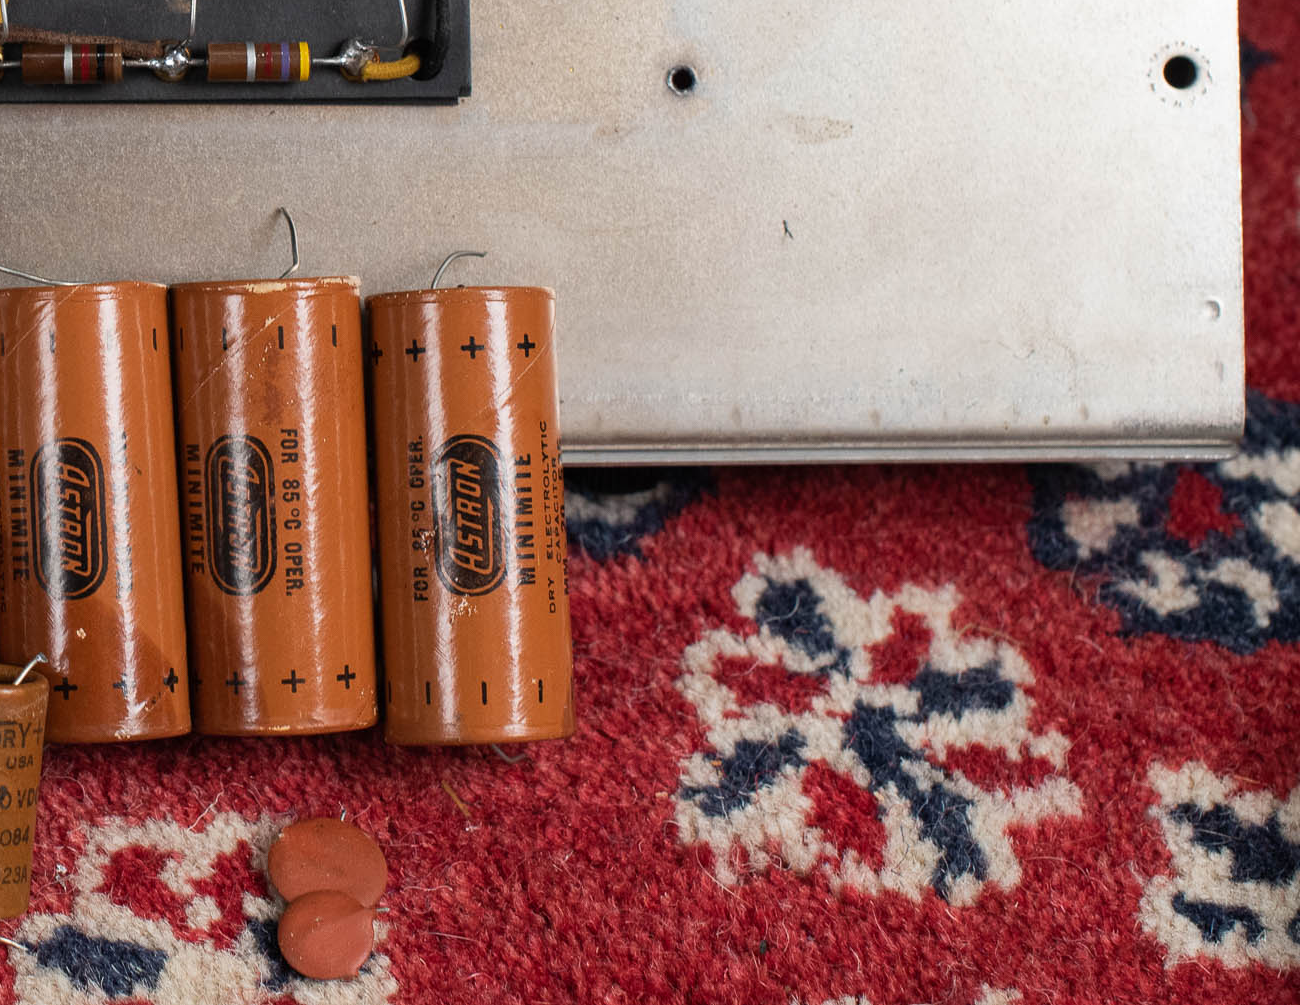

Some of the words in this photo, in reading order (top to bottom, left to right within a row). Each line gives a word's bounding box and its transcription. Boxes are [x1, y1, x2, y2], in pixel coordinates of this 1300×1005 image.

[281, 429, 298, 463] FOR
[409, 435, 425, 488] OPER.
[7, 449, 29, 582] MINIMITE
[186, 444, 205, 574] MINIMITE
[447, 458, 493, 575] ASTRON
[515, 453, 536, 585] MINIMITE
[540, 420, 553, 560] ELECTROLYTIC
[551, 457, 561, 563] CAPACITOR
[284, 543, 304, 596] OPER.
[413, 567, 428, 602] FOR
[547, 577, 556, 613] DRY
[6, 755, 34, 770] USA
